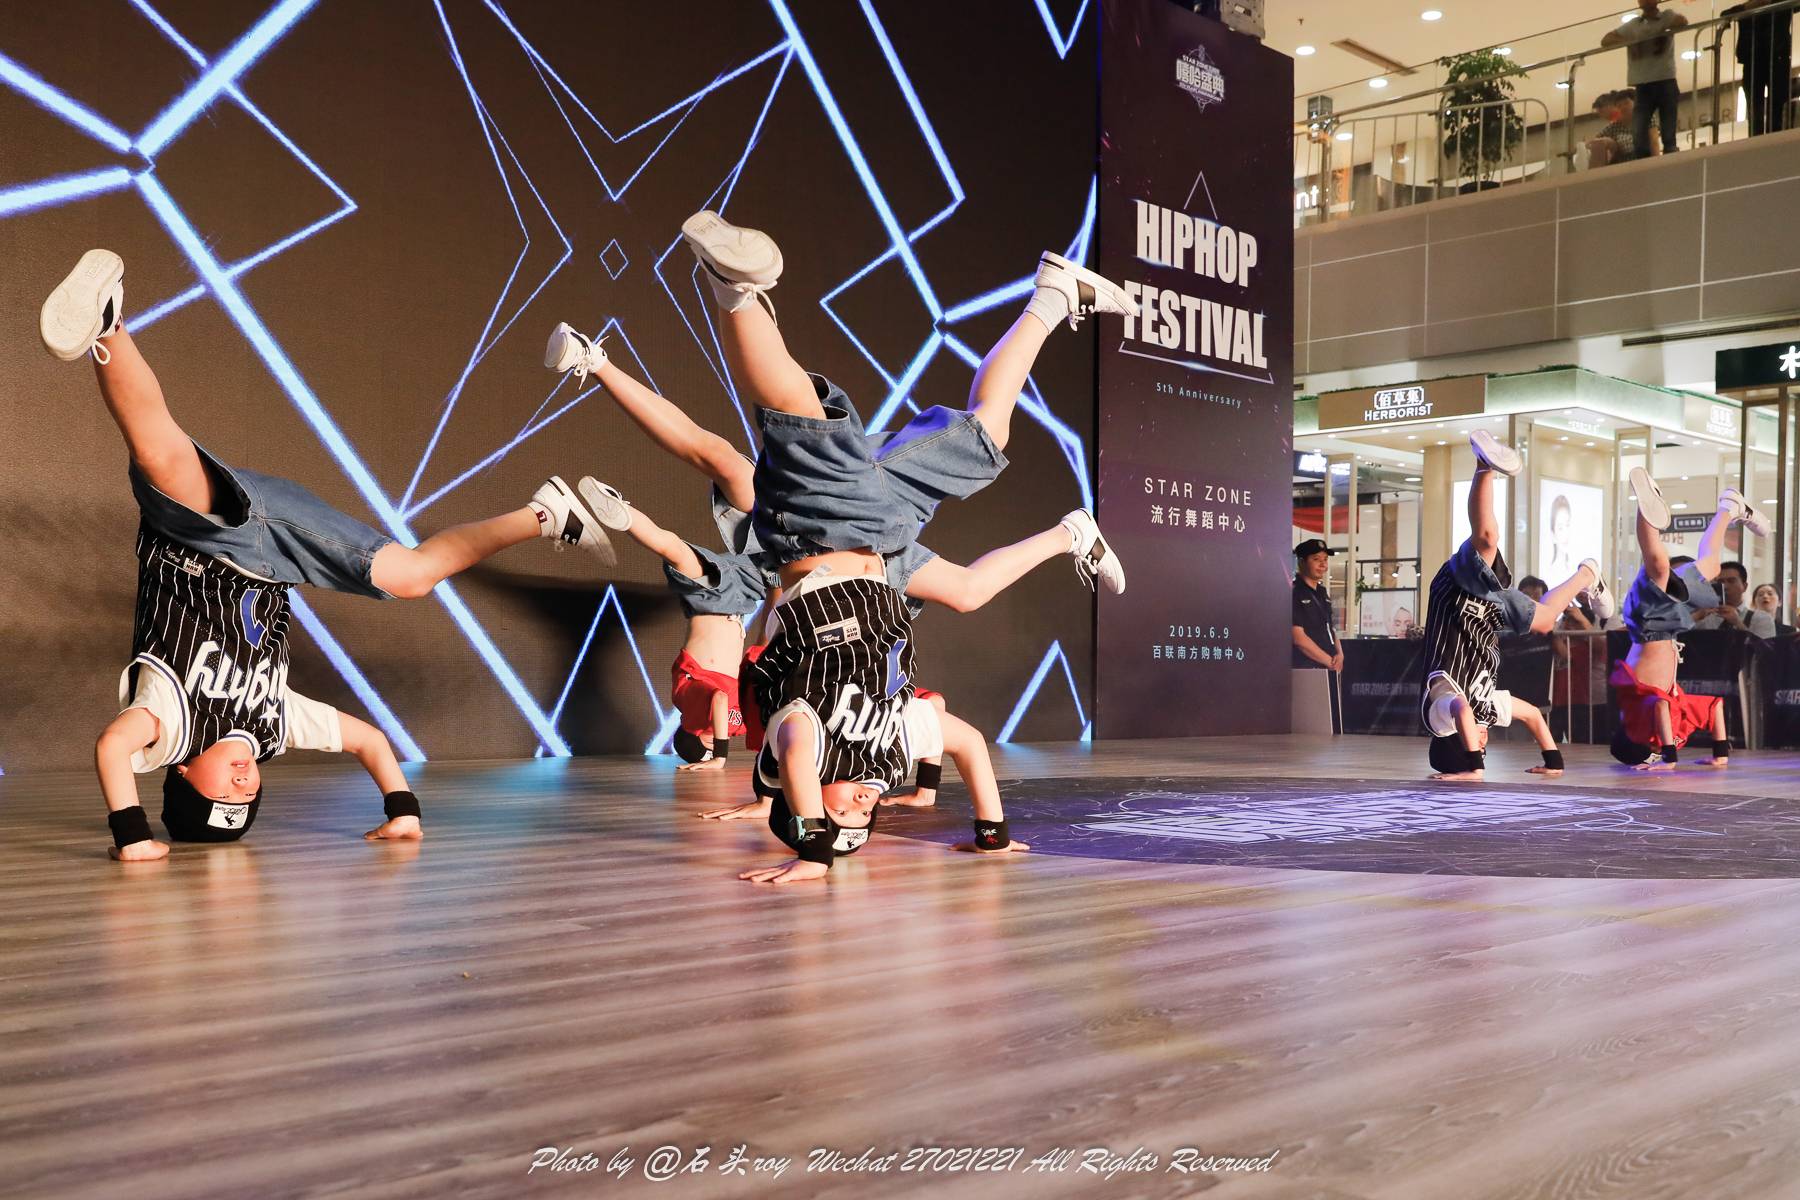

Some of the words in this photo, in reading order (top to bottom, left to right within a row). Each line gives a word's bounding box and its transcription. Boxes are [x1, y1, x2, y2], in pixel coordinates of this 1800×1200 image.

[1176, 59, 1225, 99] 嘻哈盛典
[1136, 200, 1258, 287] HIPHOP
[1123, 280, 1268, 370] FESTIVAL
[1156, 382, 1174, 395] 5th
[1179, 386, 1242, 409] Anniversary
[1364, 402, 1434, 422] HERBORIST
[1144, 477, 1194, 499] STAR
[1204, 485, 1252, 507] ZONE
[1150, 504, 1247, 534] 流行舞蹈中心
[1169, 624, 1230, 639] 2019.6.9
[1152, 645, 1246, 662] 百联南方购物中心
